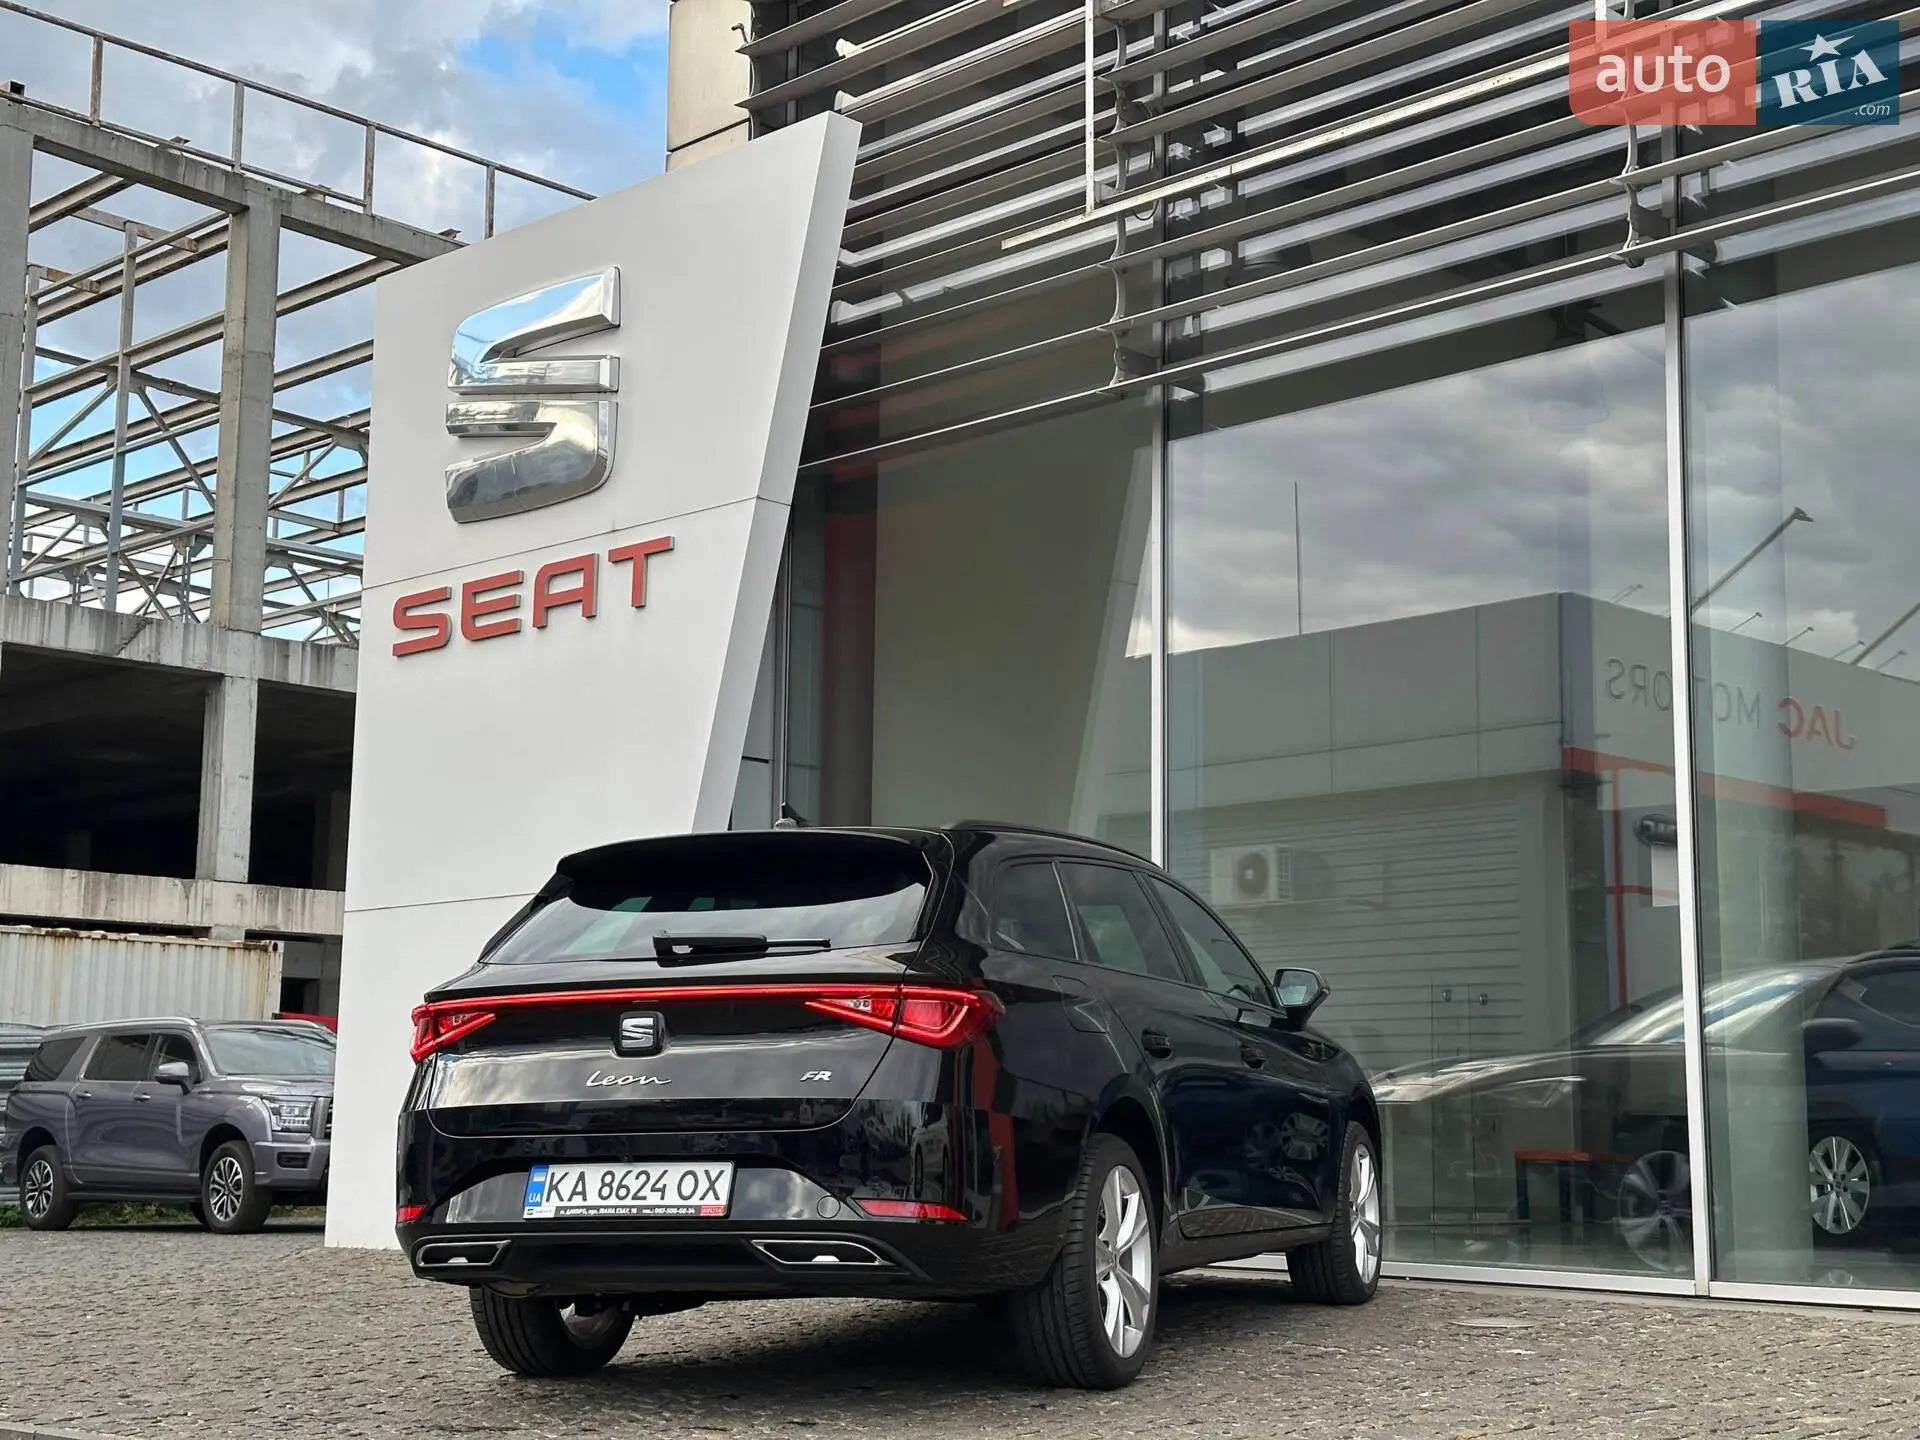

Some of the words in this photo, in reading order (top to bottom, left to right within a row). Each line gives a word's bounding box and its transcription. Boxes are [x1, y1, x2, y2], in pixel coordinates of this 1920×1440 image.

[392, 535, 675, 657] SEAT
[585, 1070, 672, 1087] Leon
[800, 1070, 832, 1082] FR
[545, 1170, 588, 1203] KA
[598, 1169, 669, 1202] 8624
[676, 1169, 725, 1201] OX
[528, 1192, 541, 1204] UA
